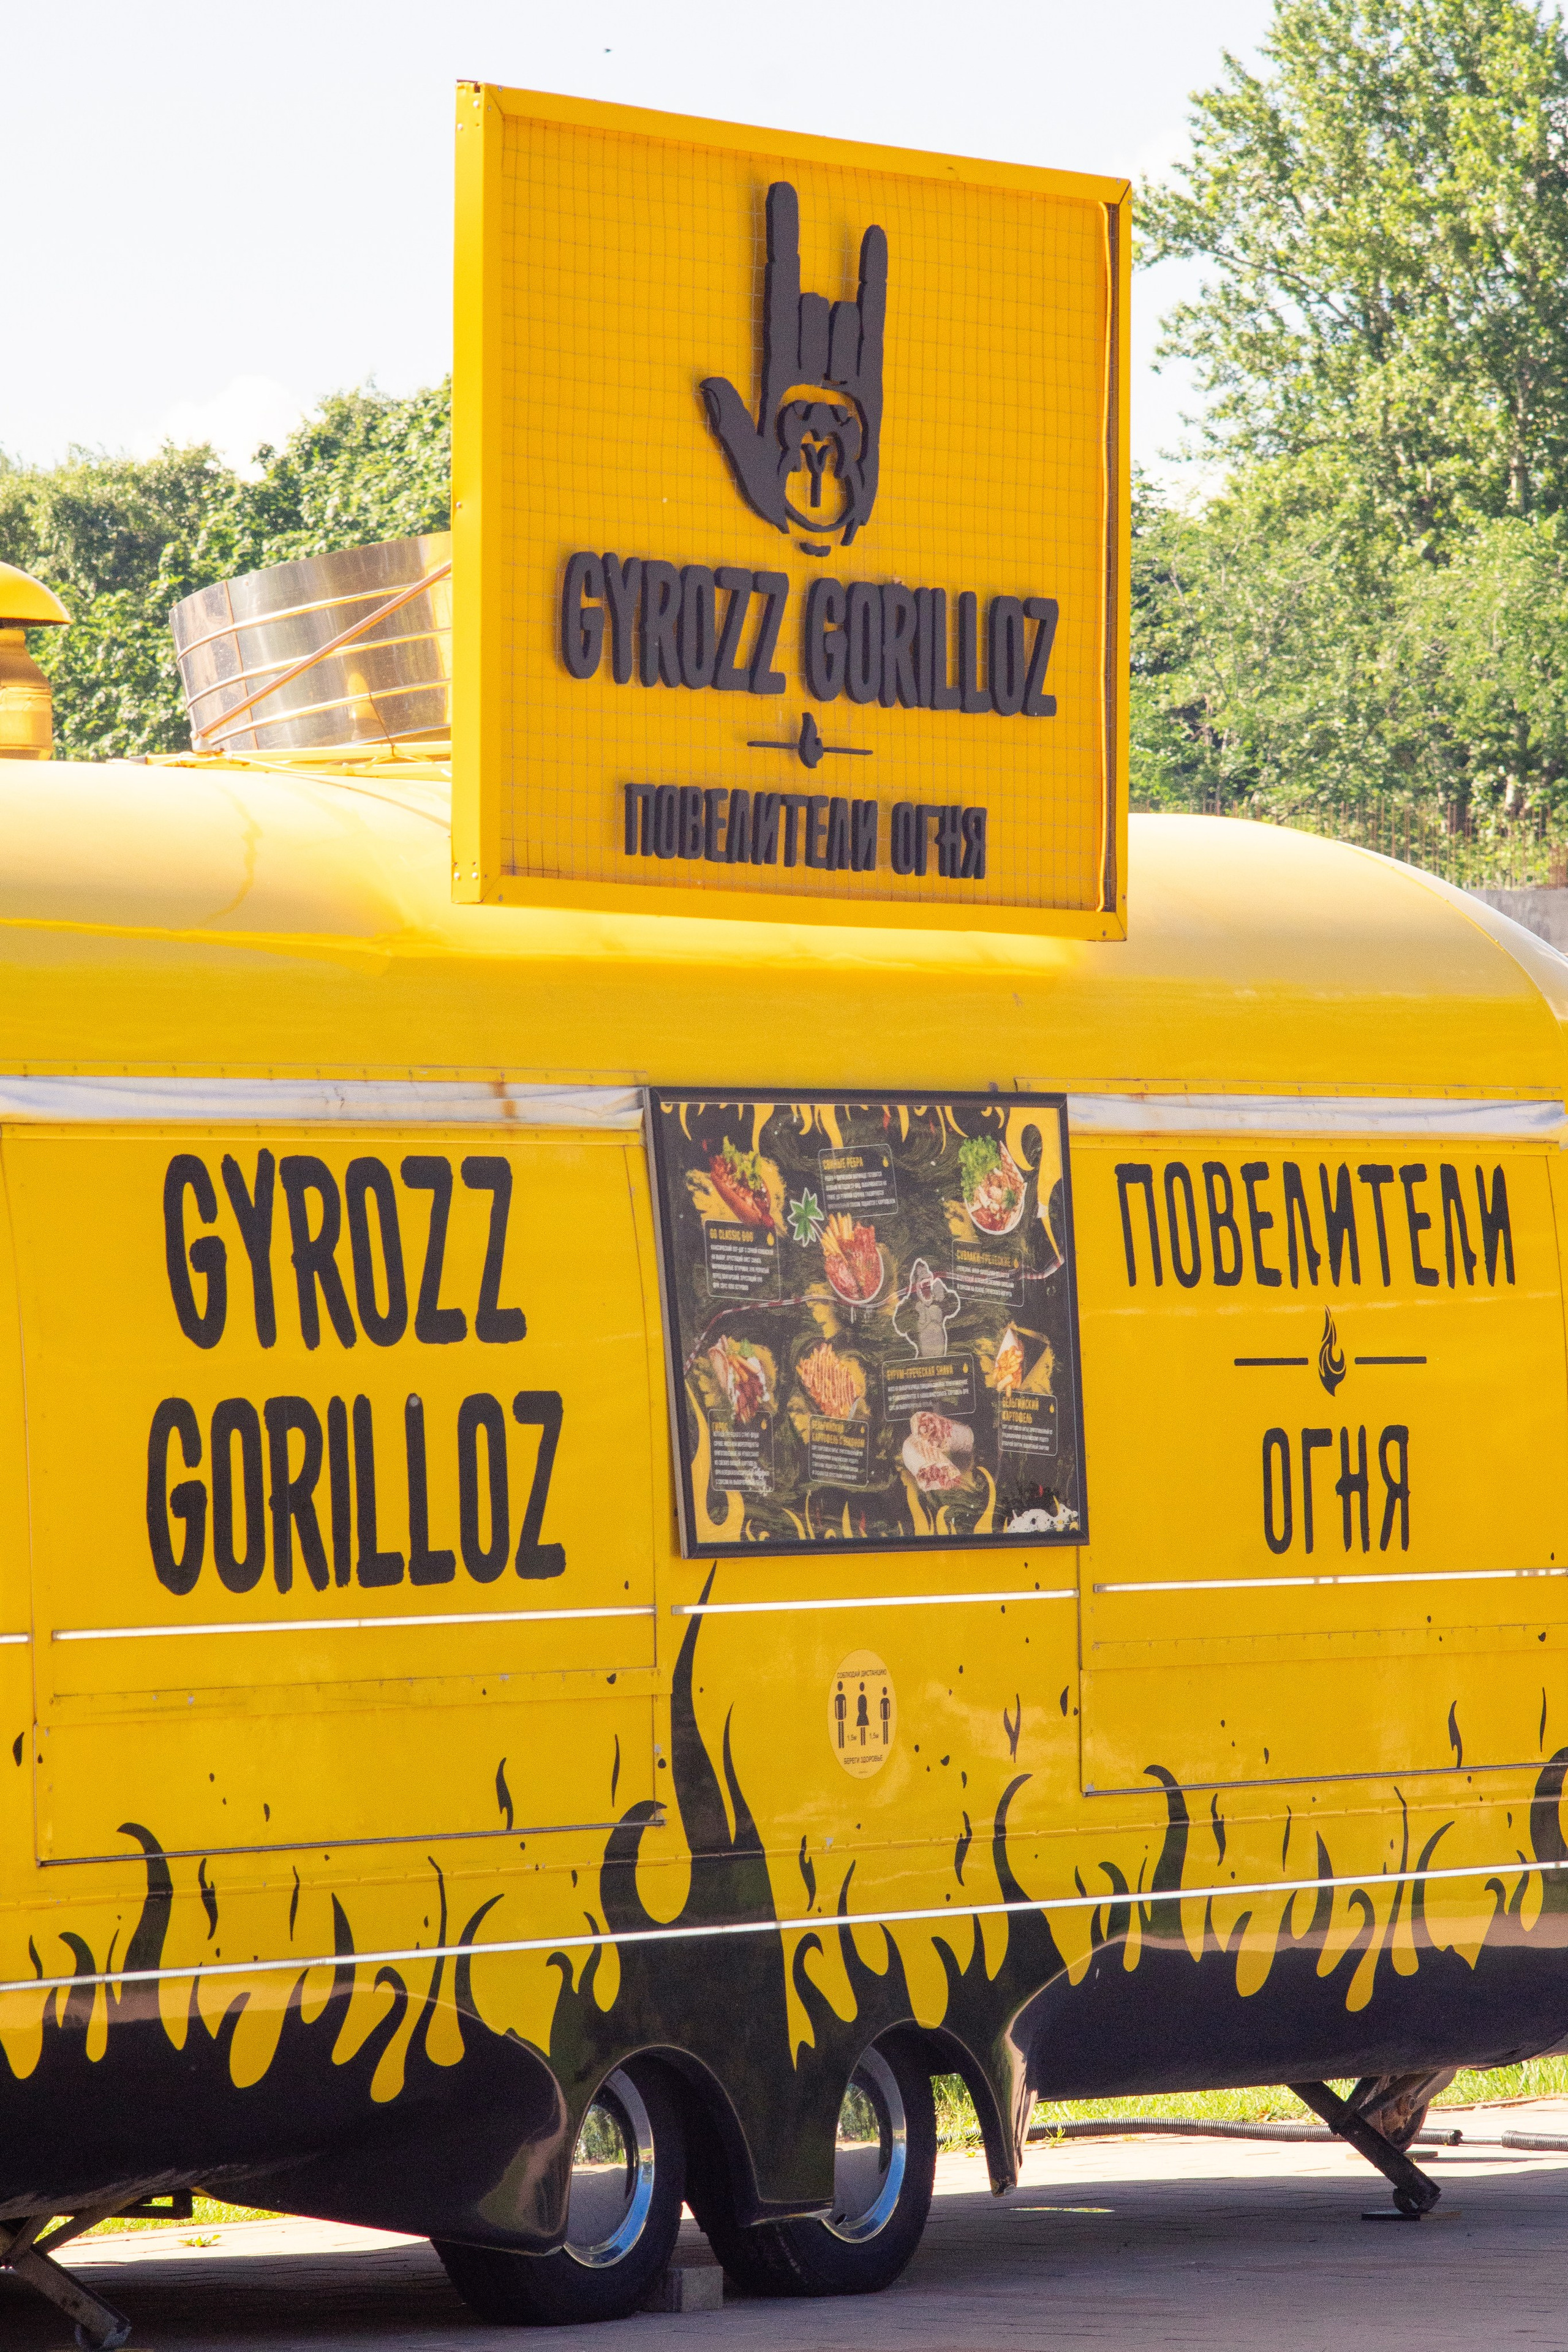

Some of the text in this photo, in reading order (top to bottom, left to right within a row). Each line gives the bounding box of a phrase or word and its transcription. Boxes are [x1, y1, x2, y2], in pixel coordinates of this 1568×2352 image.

[561, 550, 1060, 718] GYROZZ GORILLOZ
[624, 783, 987, 880] ПОВЕЛИТЕЛИ ОГНЯ
[163, 1147, 527, 1351] GYROZZ
[1114, 1160, 1517, 1289] ПОВЕЛИТЕЛИ
[146, 1390, 567, 1596] GORILLOZ
[1262, 1423, 1411, 1555] ОГНЯ
